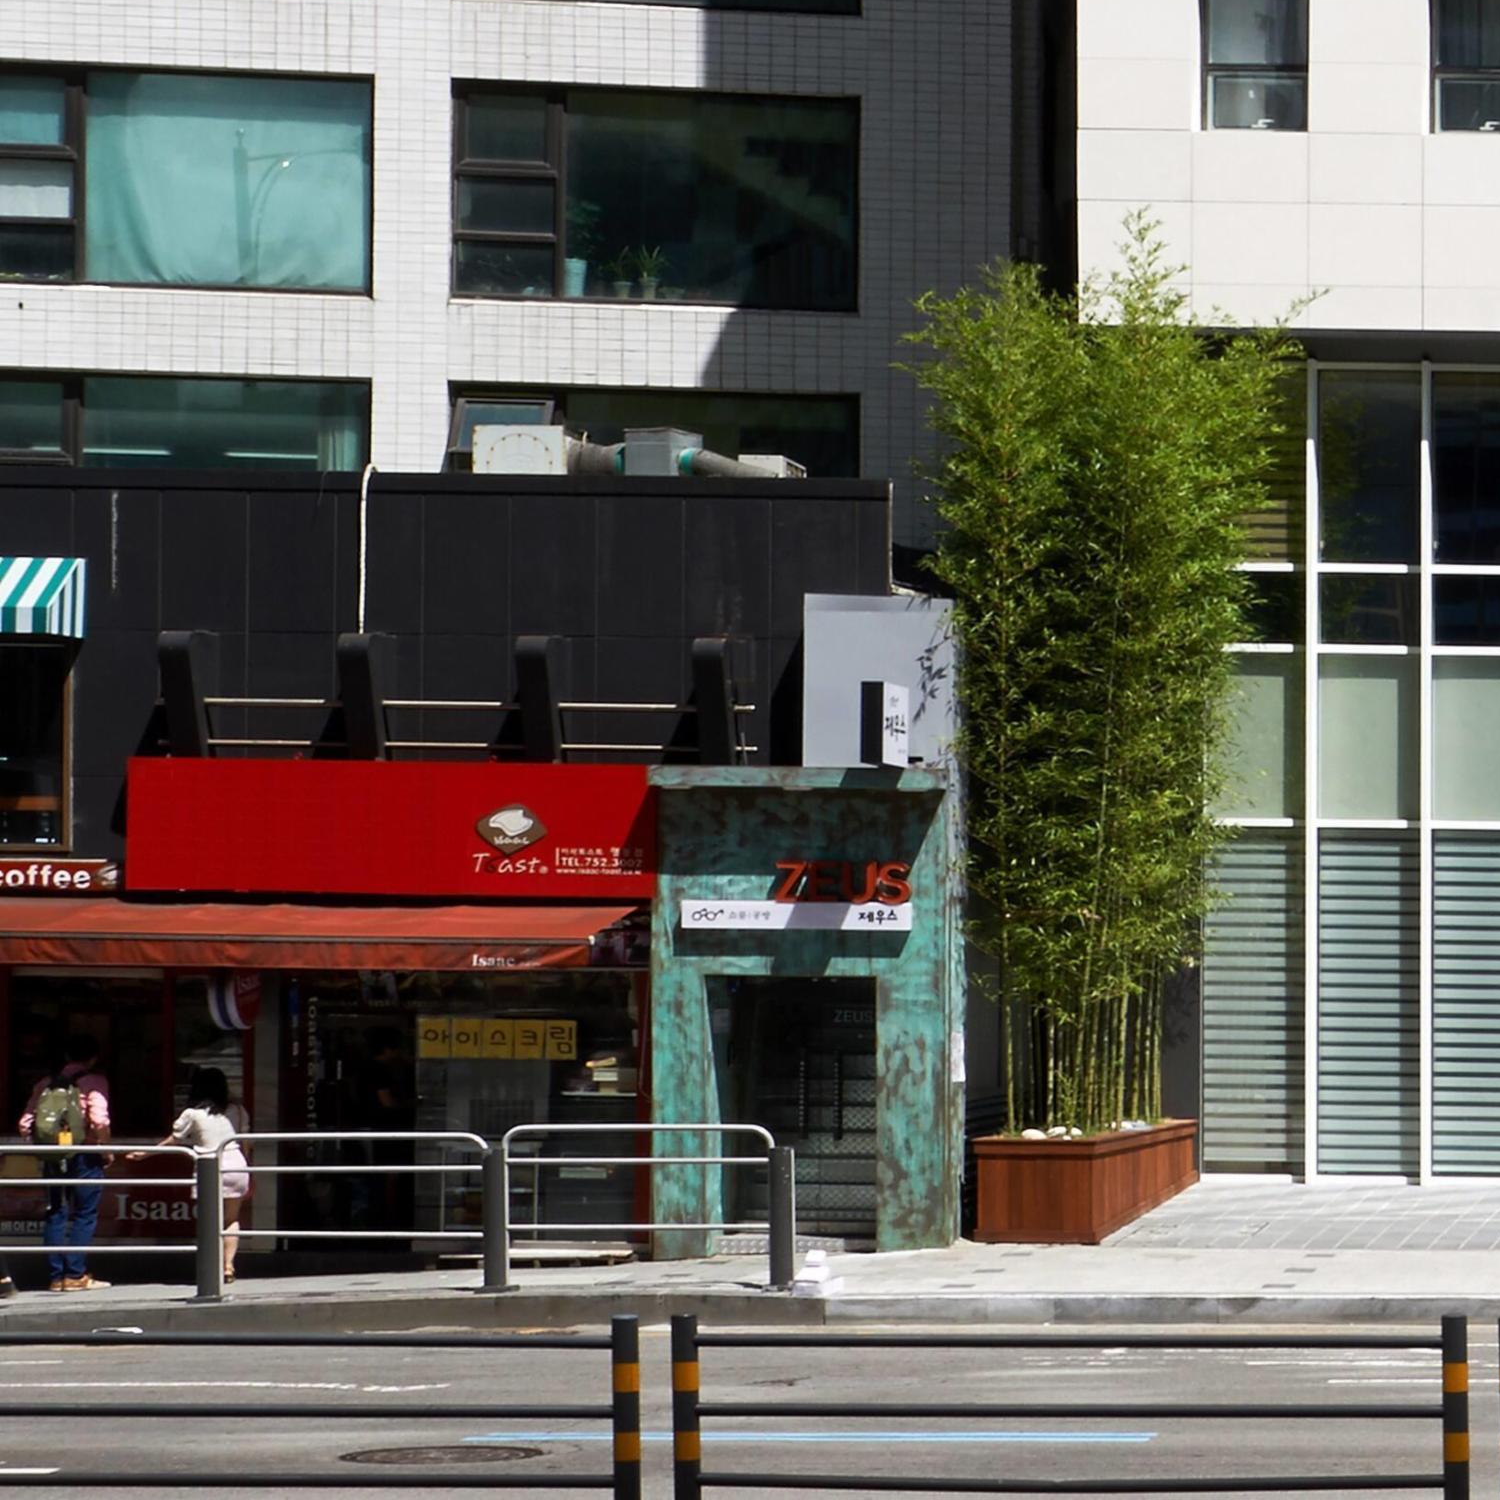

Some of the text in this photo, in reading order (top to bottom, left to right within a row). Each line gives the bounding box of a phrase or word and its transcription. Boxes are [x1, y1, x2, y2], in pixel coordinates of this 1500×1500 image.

[0, 865, 91, 888] offee
[774, 860, 911, 905] ZEUS
[858, 908, 898, 925] 제우스
[833, 1009, 873, 1023] ZEUS
[423, 1026, 573, 1054] 아이스크림
